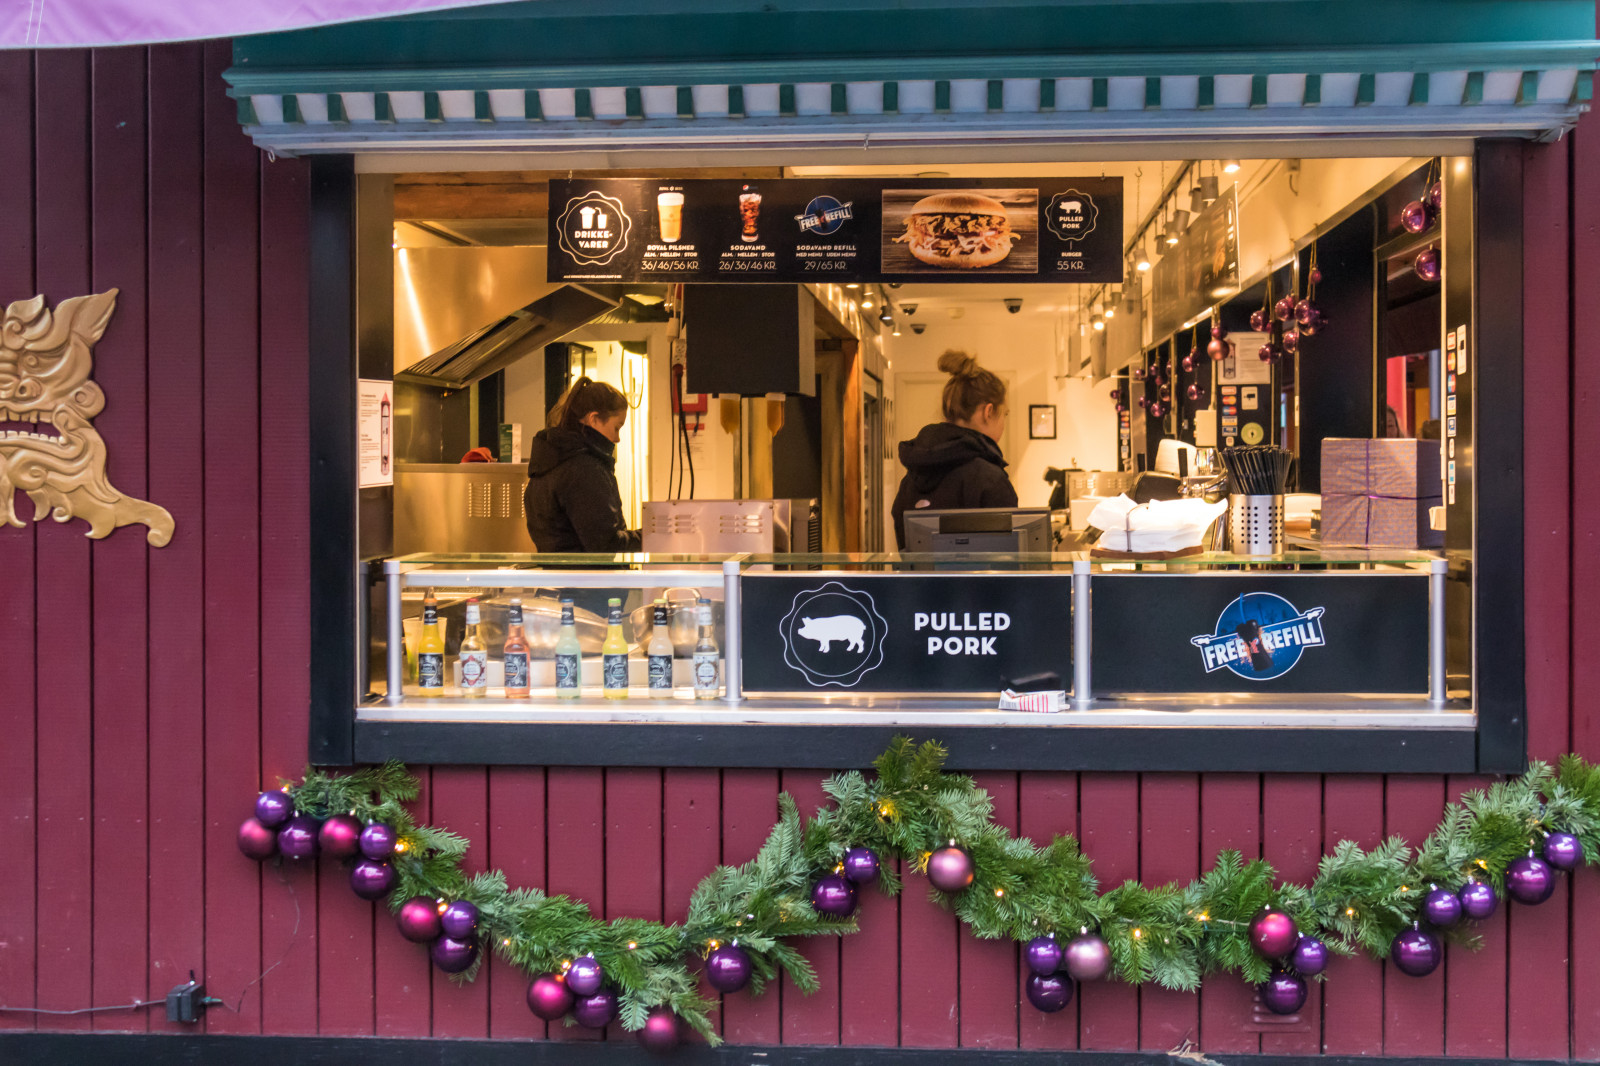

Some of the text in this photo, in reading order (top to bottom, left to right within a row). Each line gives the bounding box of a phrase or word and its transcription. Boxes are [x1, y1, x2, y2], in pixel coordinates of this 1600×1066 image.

[801, 207, 851, 230] FREE REFILL
[574, 230, 613, 239] DRIKKE-
[579, 240, 609, 248] VARER
[1057, 260, 1070, 270] 55
[914, 612, 1011, 631] PULLED
[927, 636, 997, 655] PORK
[1204, 621, 1321, 669] FREE REFILL
